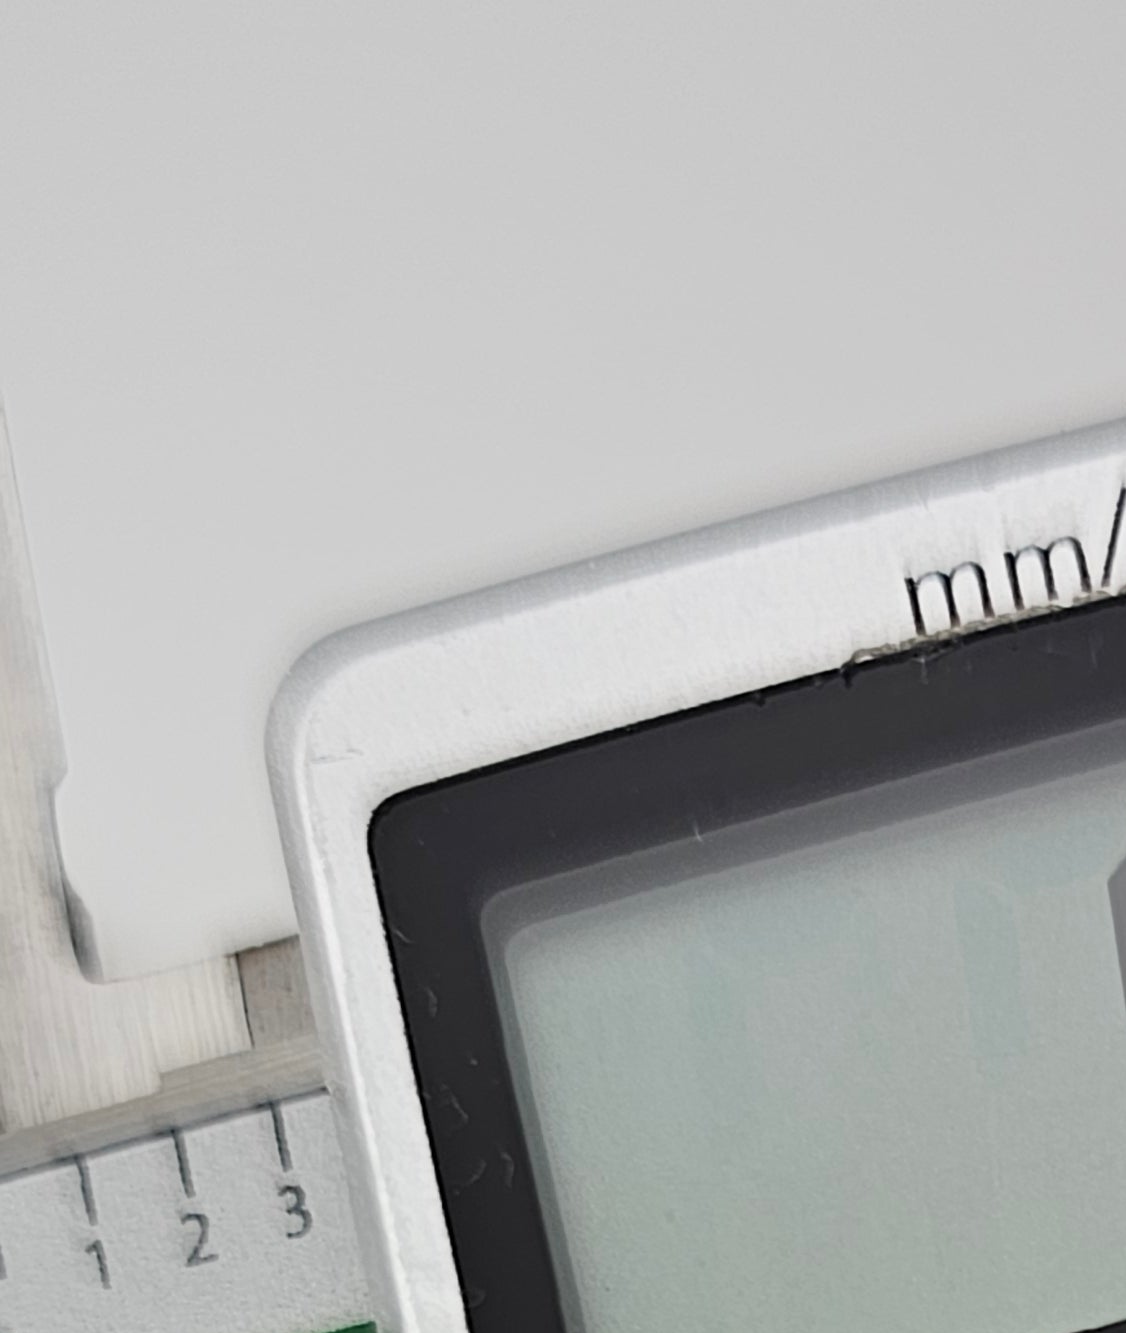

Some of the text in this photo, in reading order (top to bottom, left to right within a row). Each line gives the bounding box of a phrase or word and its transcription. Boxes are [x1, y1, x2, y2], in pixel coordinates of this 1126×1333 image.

[85, 1185, 312, 1289] 1 2 3
